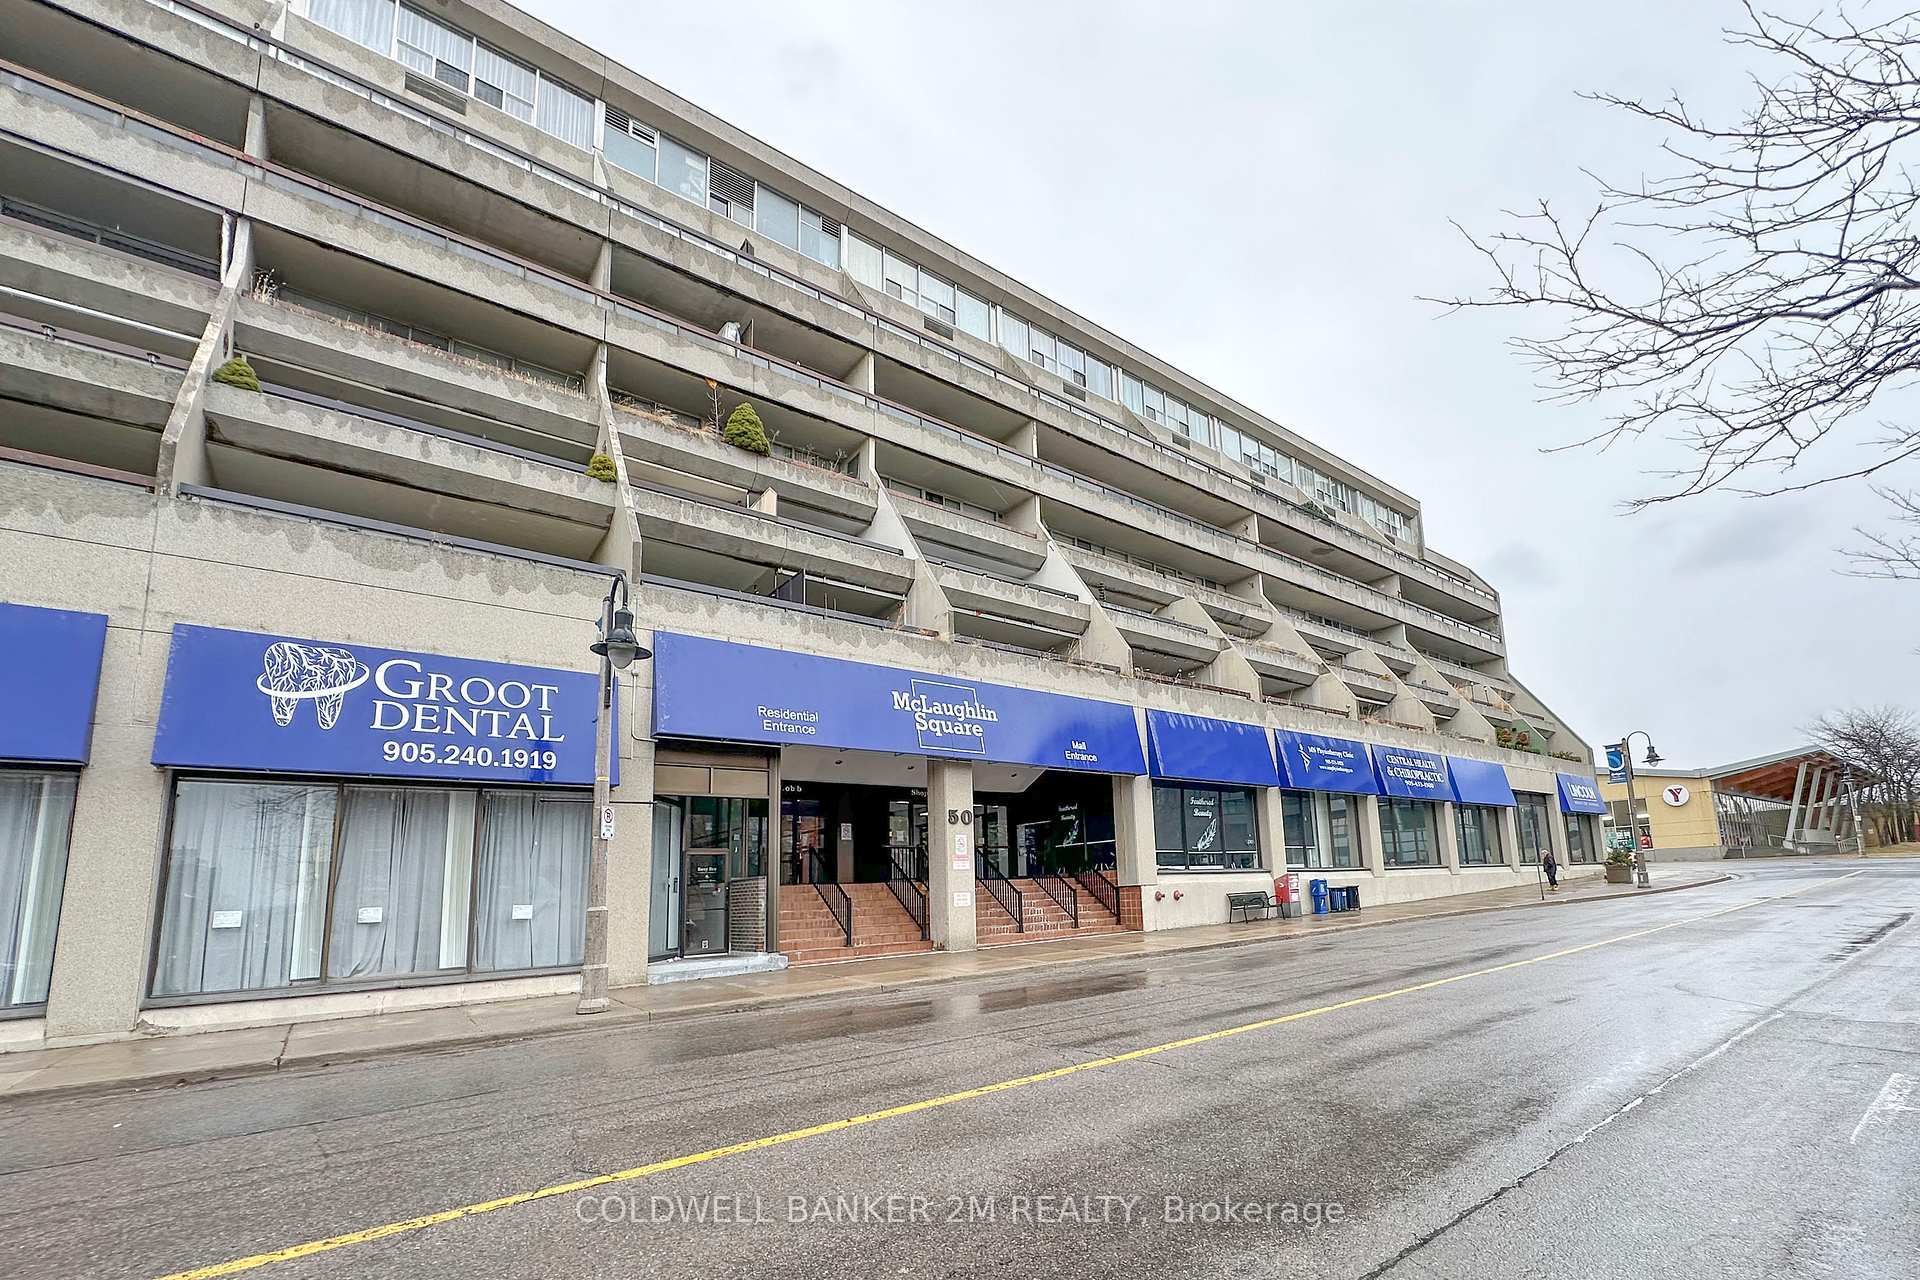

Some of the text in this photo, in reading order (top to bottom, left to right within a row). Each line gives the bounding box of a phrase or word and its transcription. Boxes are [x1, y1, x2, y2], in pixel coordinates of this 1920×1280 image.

[374, 659, 559, 712] GROOT
[757, 705, 819, 723] Residential
[891, 691, 999, 722] McLaughlin
[369, 700, 566, 742] DENTAL
[763, 719, 816, 735] Entrance
[914, 711, 984, 738] Square
[1071, 740, 1087, 751] Mall
[383, 740, 557, 770] 905.240.1919
[1064, 750, 1098, 762] Entrance
[1385, 754, 1437, 770] CENTRAL HEALTH
[1386, 765, 1445, 783] & CHIROPRACTIC
[947, 809, 973, 826] 50
